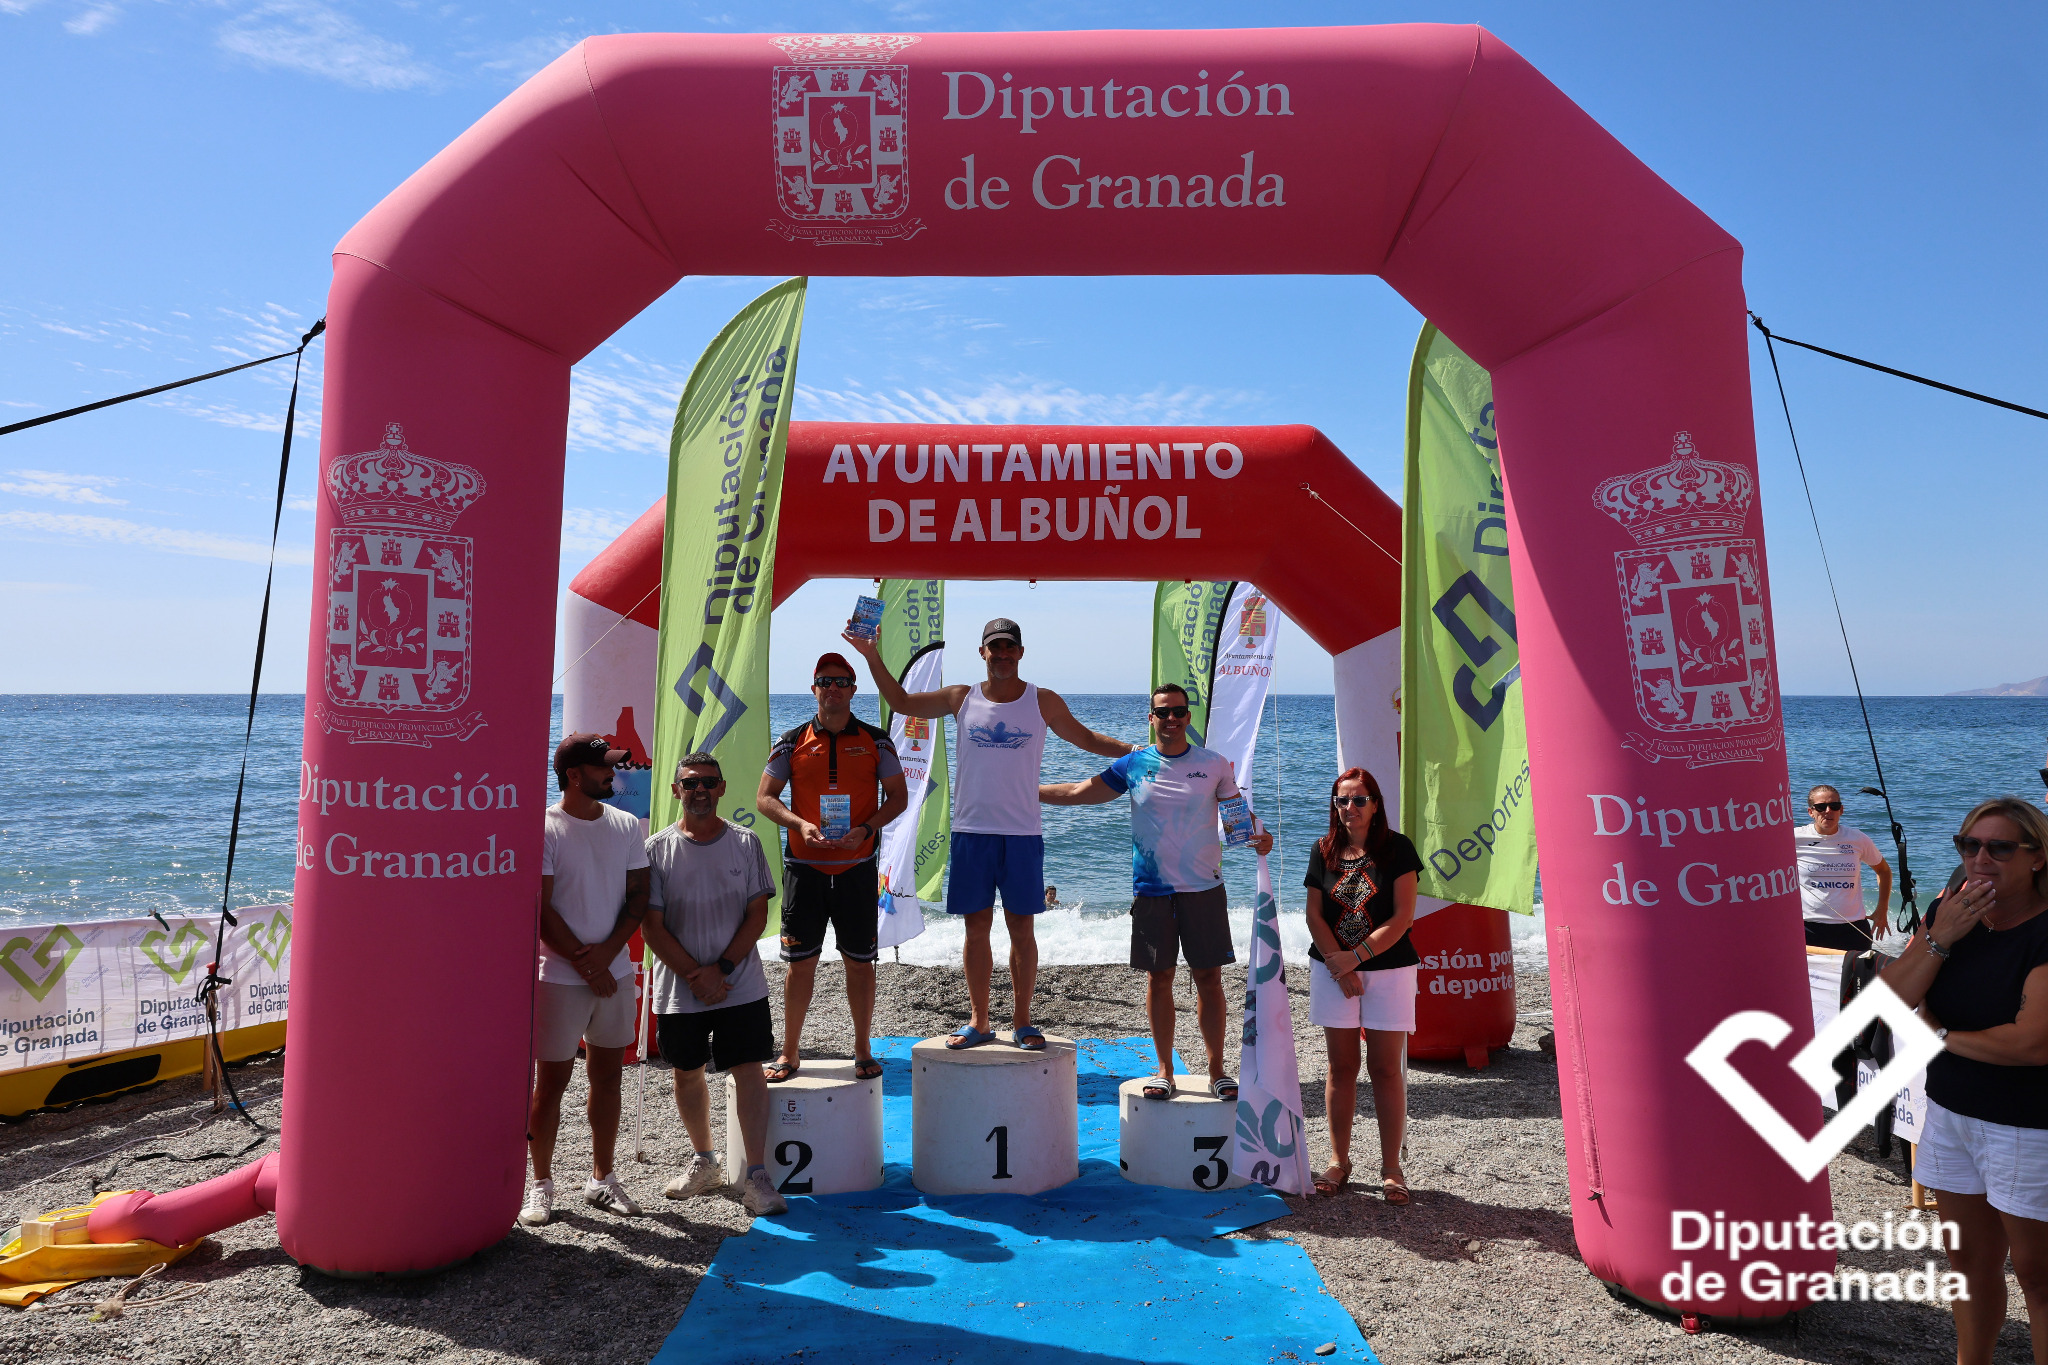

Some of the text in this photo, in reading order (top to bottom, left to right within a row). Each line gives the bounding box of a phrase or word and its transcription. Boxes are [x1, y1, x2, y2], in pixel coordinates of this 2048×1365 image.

[941, 70, 1294, 134] Diputación
[944, 150, 1287, 210] de Granada
[822, 441, 1244, 484] AYUNTAMIENTO
[704, 374, 751, 626] Diputación
[867, 484, 1202, 543] DE ALBUÑOL
[727, 555, 761, 615] de
[357, 728, 419, 740] GRANADA
[1697, 748, 1754, 761] GRANADA
[299, 760, 519, 816] Diputación
[1429, 759, 1530, 881] Deportes
[1586, 783, 1793, 848] Diputació
[325, 832, 516, 879] Granada
[1602, 861, 1800, 907] de Grana
[1811, 881, 1855, 889] SANICOR
[1417, 948, 1512, 972] sión por
[248, 1001, 262, 1015] de
[250, 980, 289, 999] Diputaci
[1429, 971, 1513, 999] deporte
[0, 1008, 95, 1038] iputación
[14, 1027, 98, 1054] Granada
[136, 1010, 221, 1034] de Granaa
[774, 1139, 814, 1195] 2
[985, 1125, 1013, 1180] 1
[1192, 1135, 1229, 1190] 3
